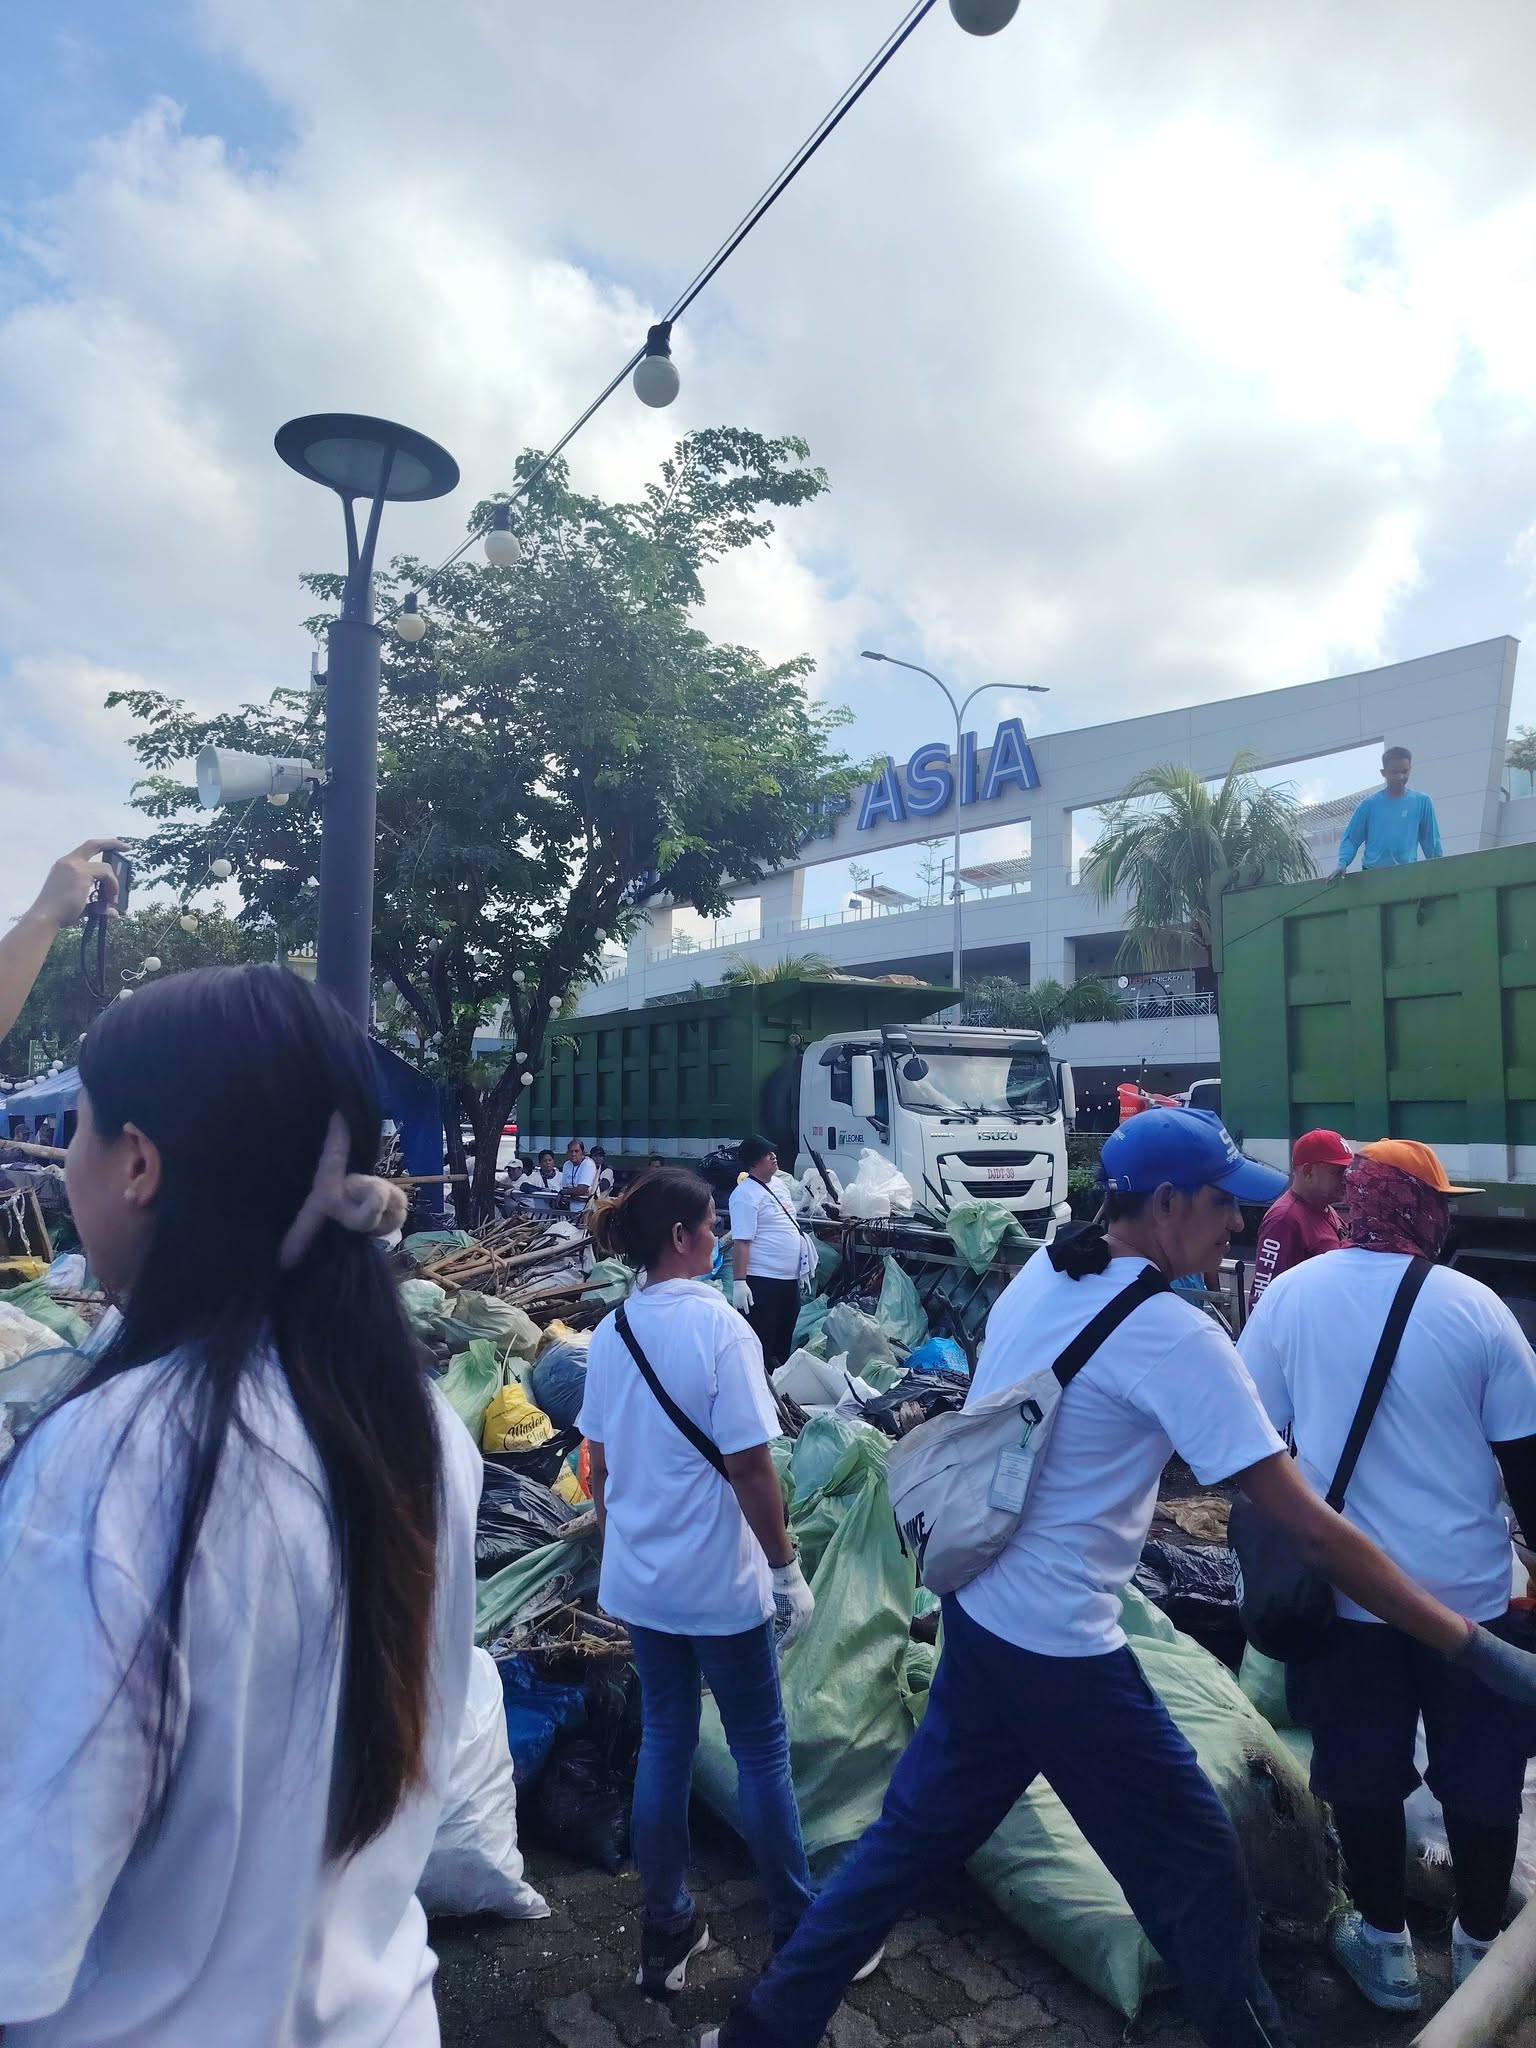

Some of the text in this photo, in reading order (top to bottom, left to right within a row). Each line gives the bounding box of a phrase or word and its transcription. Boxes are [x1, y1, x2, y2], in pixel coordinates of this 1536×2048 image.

[857, 718, 1041, 831] ASIA
[978, 1130, 1018, 1141] ISUZU
[1258, 1238, 1281, 1269] OFF
[508, 1415, 545, 1438] Master
